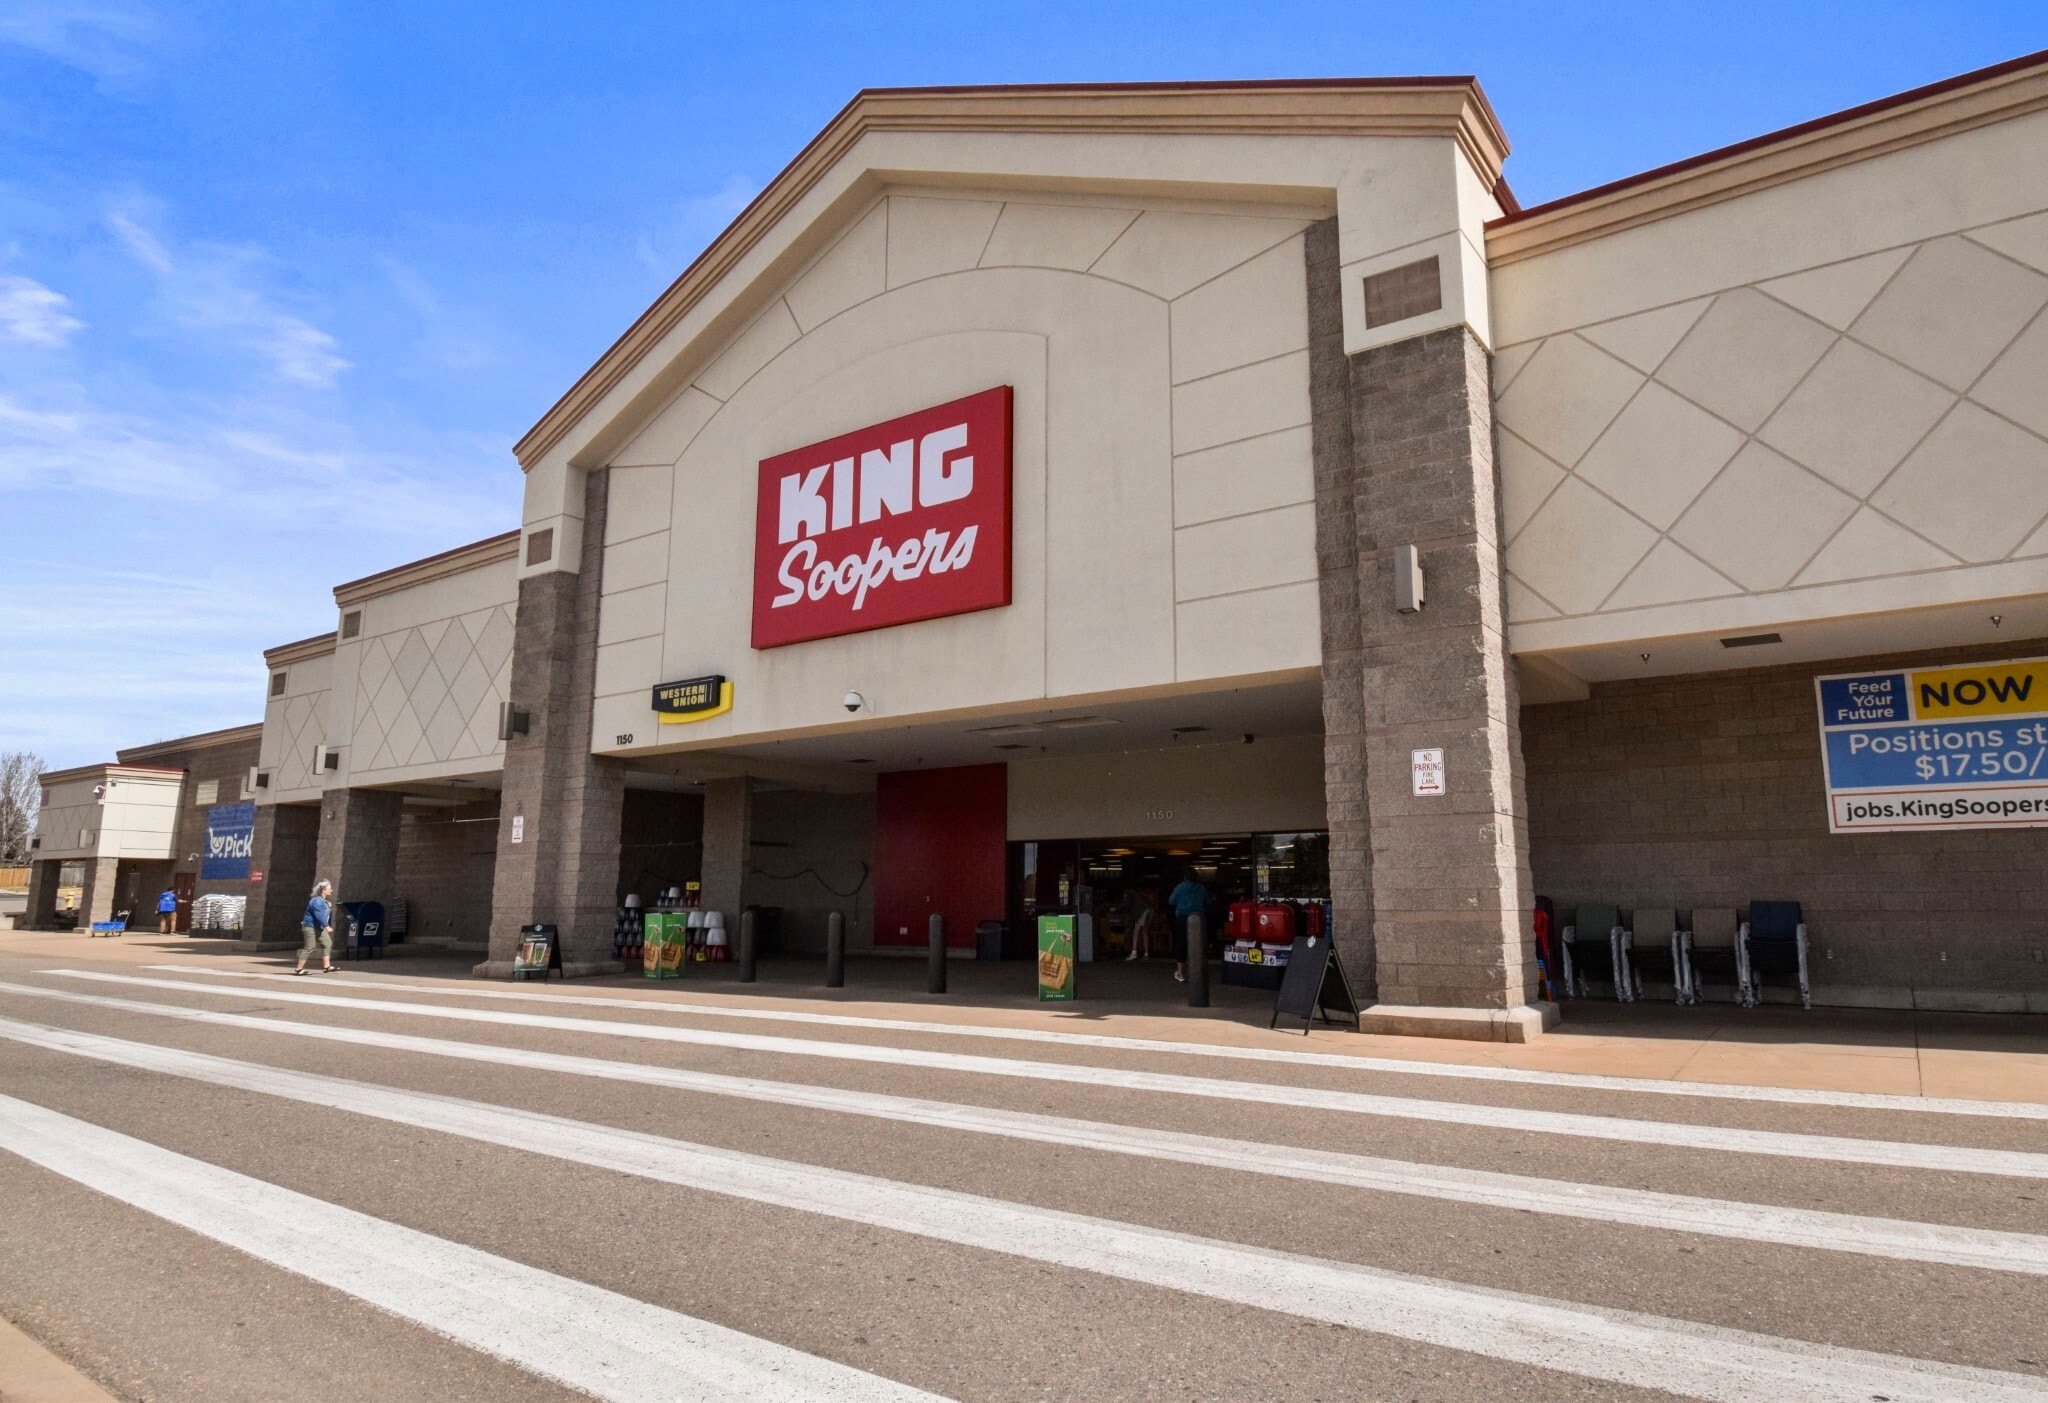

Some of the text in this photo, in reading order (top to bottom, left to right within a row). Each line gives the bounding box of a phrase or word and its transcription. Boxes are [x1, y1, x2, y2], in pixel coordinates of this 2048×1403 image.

[777, 422, 974, 545] KING
[771, 524, 979, 611] Soopers
[660, 684, 705, 699] WESTERN
[1848, 680, 1891, 694] Feed
[1920, 674, 2033, 708] NOW
[673, 694, 704, 707] UNION
[1852, 695, 1893, 707] Your
[1838, 707, 1895, 720] Future
[616, 733, 633, 745] 1150
[1849, 728, 2004, 755] Positions
[1424, 753, 1432, 761] NO
[1414, 762, 1442, 772] PARKING
[1145, 810, 1173, 820] 1150
